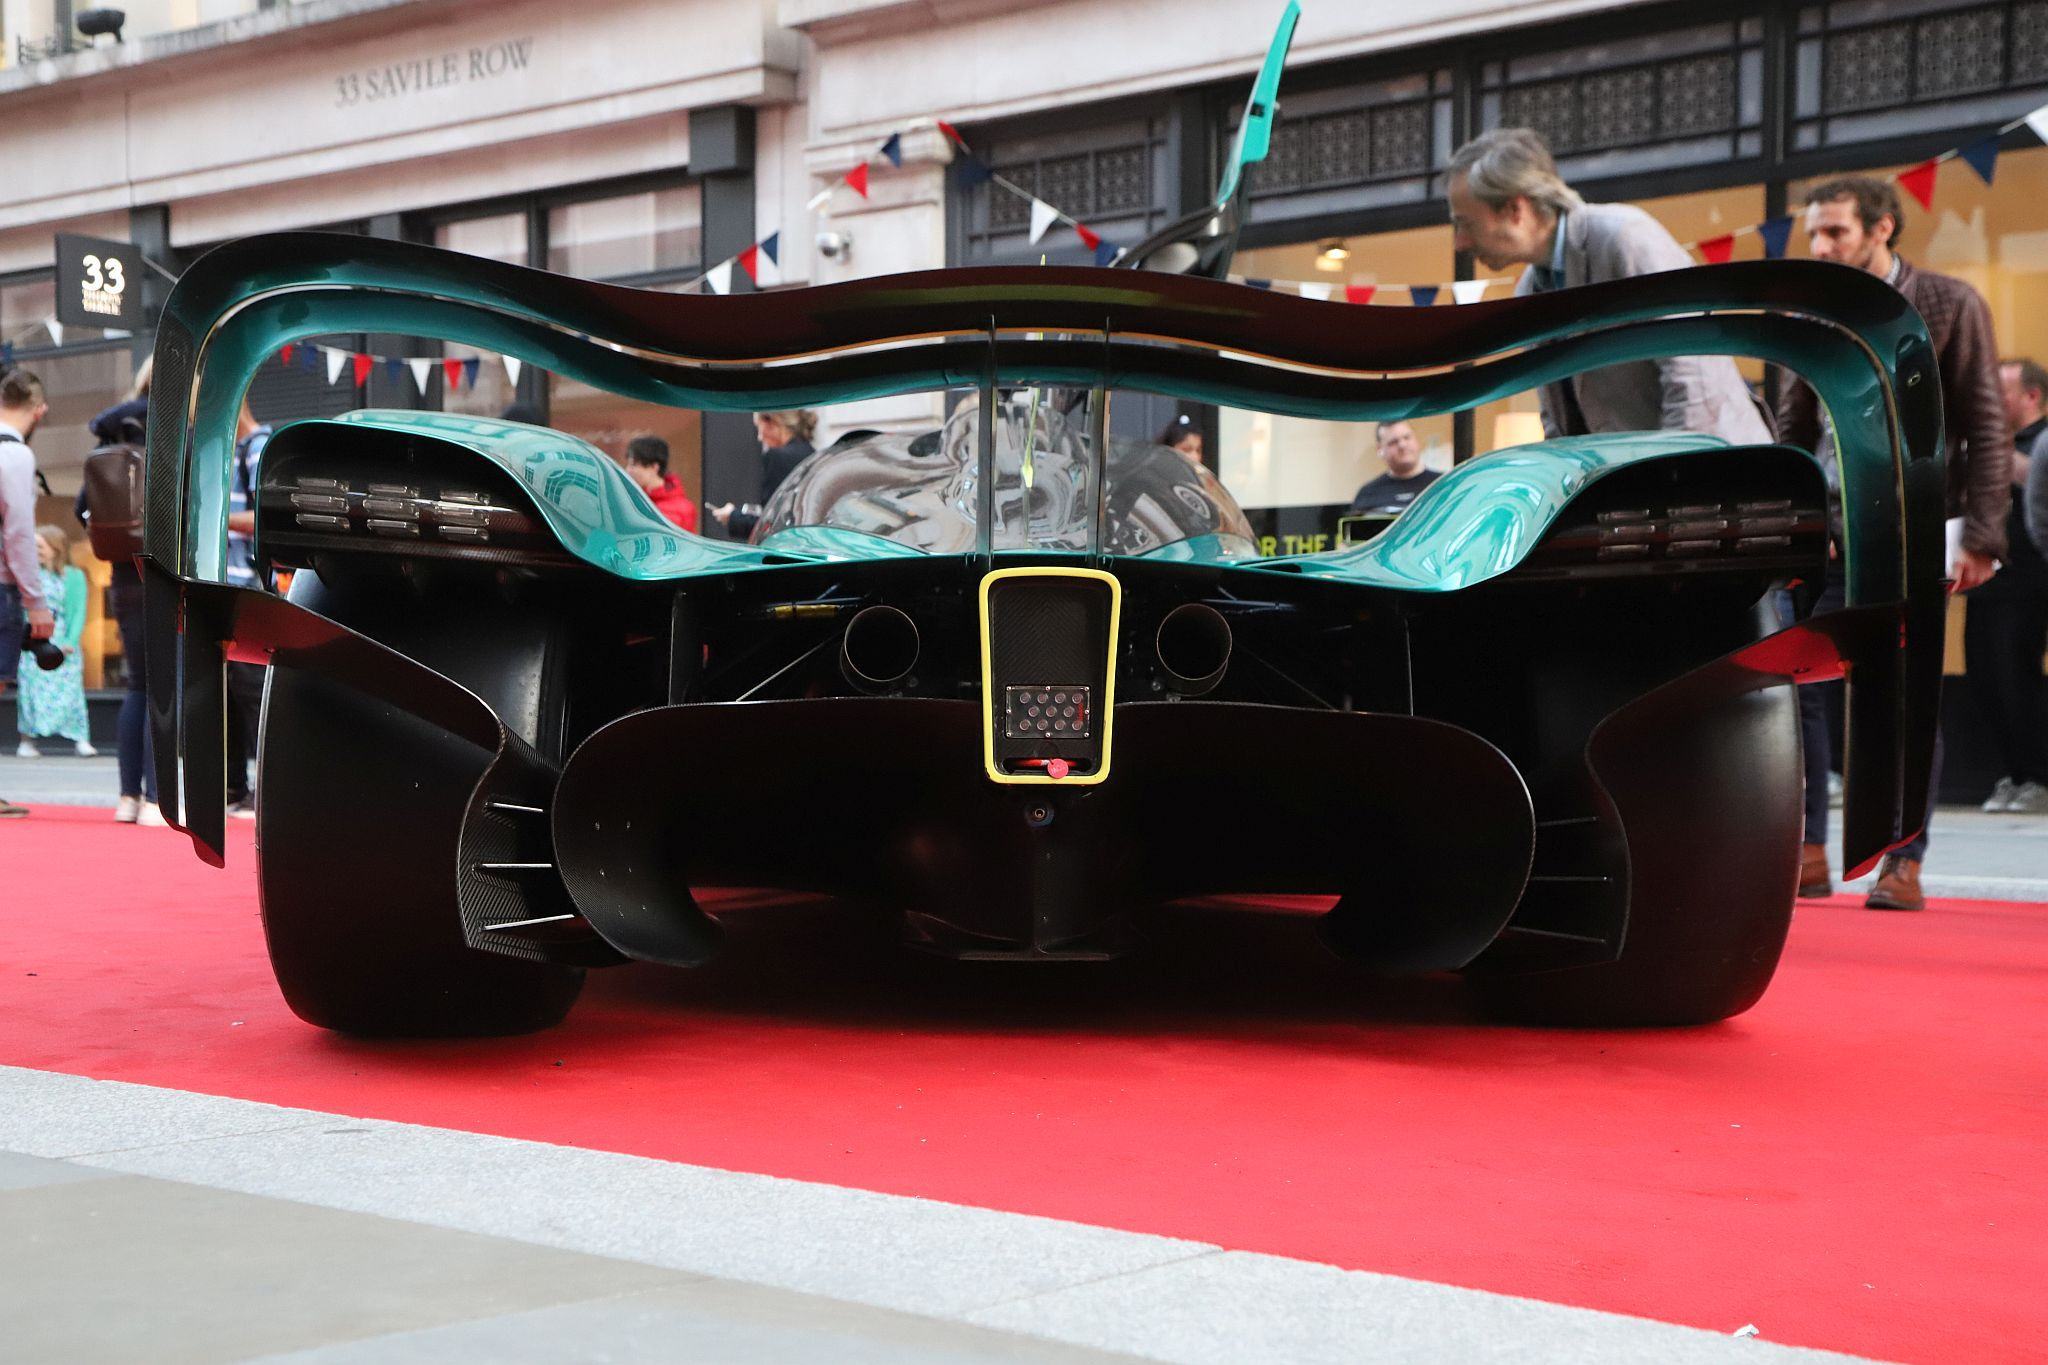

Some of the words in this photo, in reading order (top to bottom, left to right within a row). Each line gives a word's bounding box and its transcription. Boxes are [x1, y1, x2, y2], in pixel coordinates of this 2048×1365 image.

[335, 72, 360, 108] 33
[365, 52, 461, 102] SAVILE
[468, 36, 533, 80] ROW
[82, 255, 126, 294] 33
[1256, 535, 1277, 557] R
[1282, 533, 1328, 555] THE
